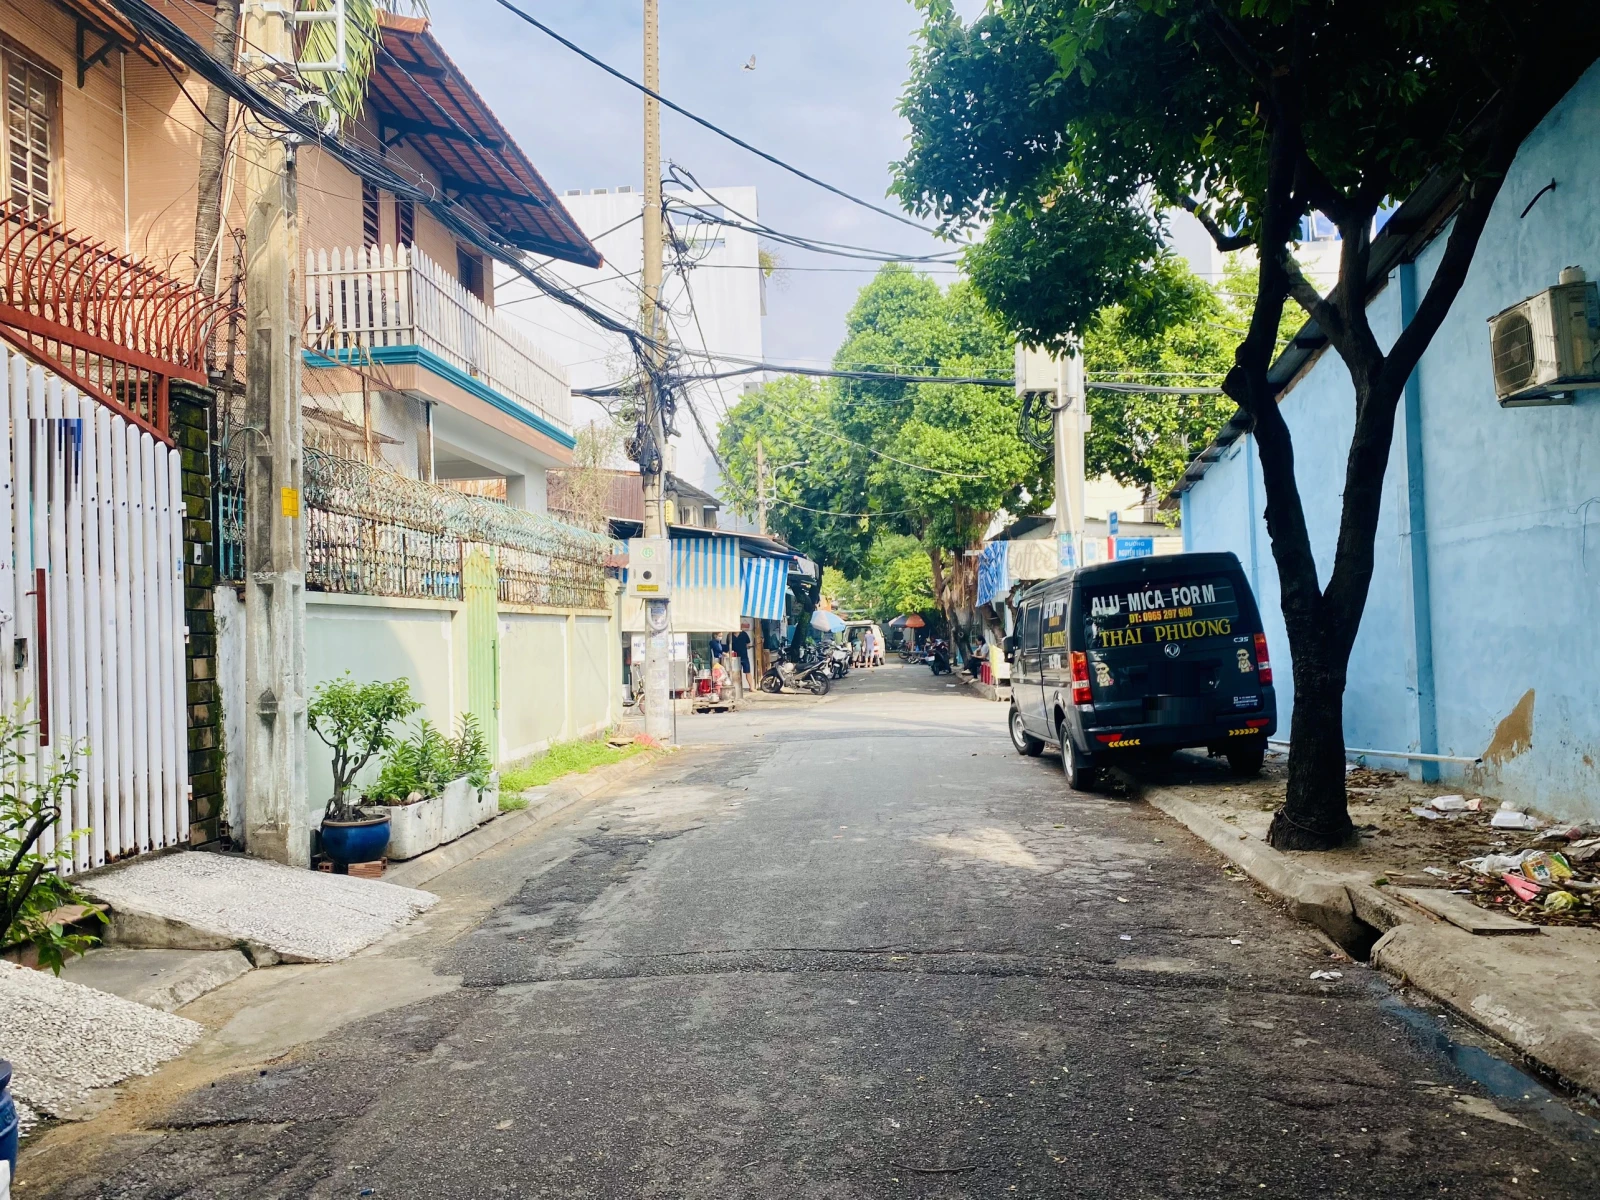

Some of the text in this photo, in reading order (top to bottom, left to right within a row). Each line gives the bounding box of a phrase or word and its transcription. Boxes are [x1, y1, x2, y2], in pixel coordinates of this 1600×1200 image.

[1143, 611, 1161, 621] 0965
[1163, 609, 1176, 619] 297
[1100, 618, 1231, 648] THÁI PHƯƠNG
